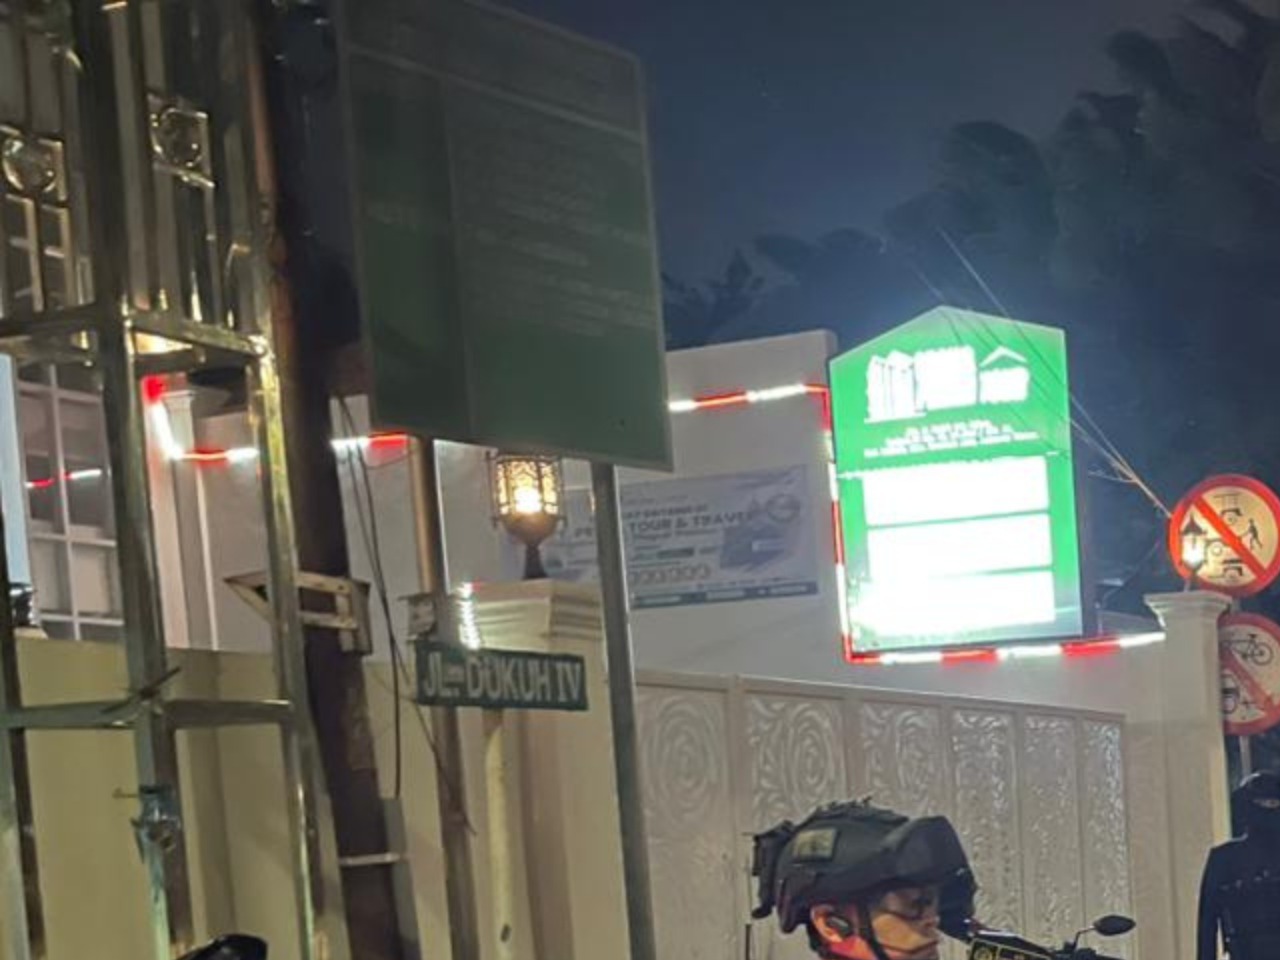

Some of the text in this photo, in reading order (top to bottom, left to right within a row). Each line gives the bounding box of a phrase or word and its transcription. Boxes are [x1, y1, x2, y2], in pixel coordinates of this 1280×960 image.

[629, 516, 673, 533] TOUR
[467, 655, 550, 701] DUKUH
[556, 661, 582, 702] IV
